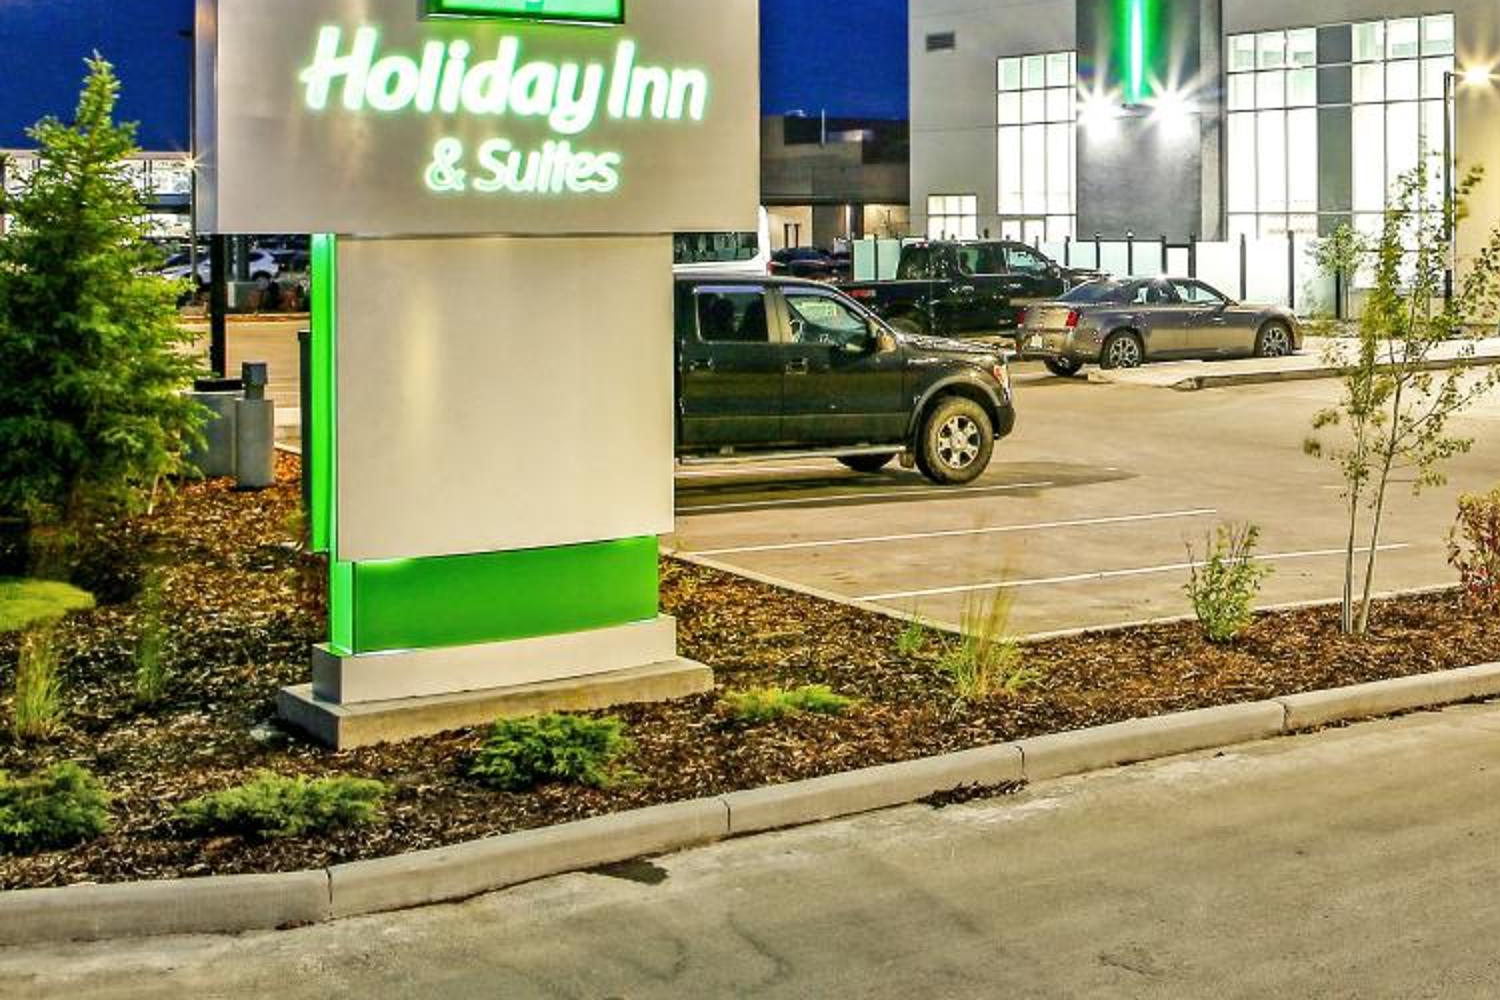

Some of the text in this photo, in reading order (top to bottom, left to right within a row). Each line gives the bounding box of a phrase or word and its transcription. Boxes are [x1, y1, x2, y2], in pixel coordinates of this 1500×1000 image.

[300, 26, 708, 134] Holiday Inn
[426, 137, 621, 194] & Suites
